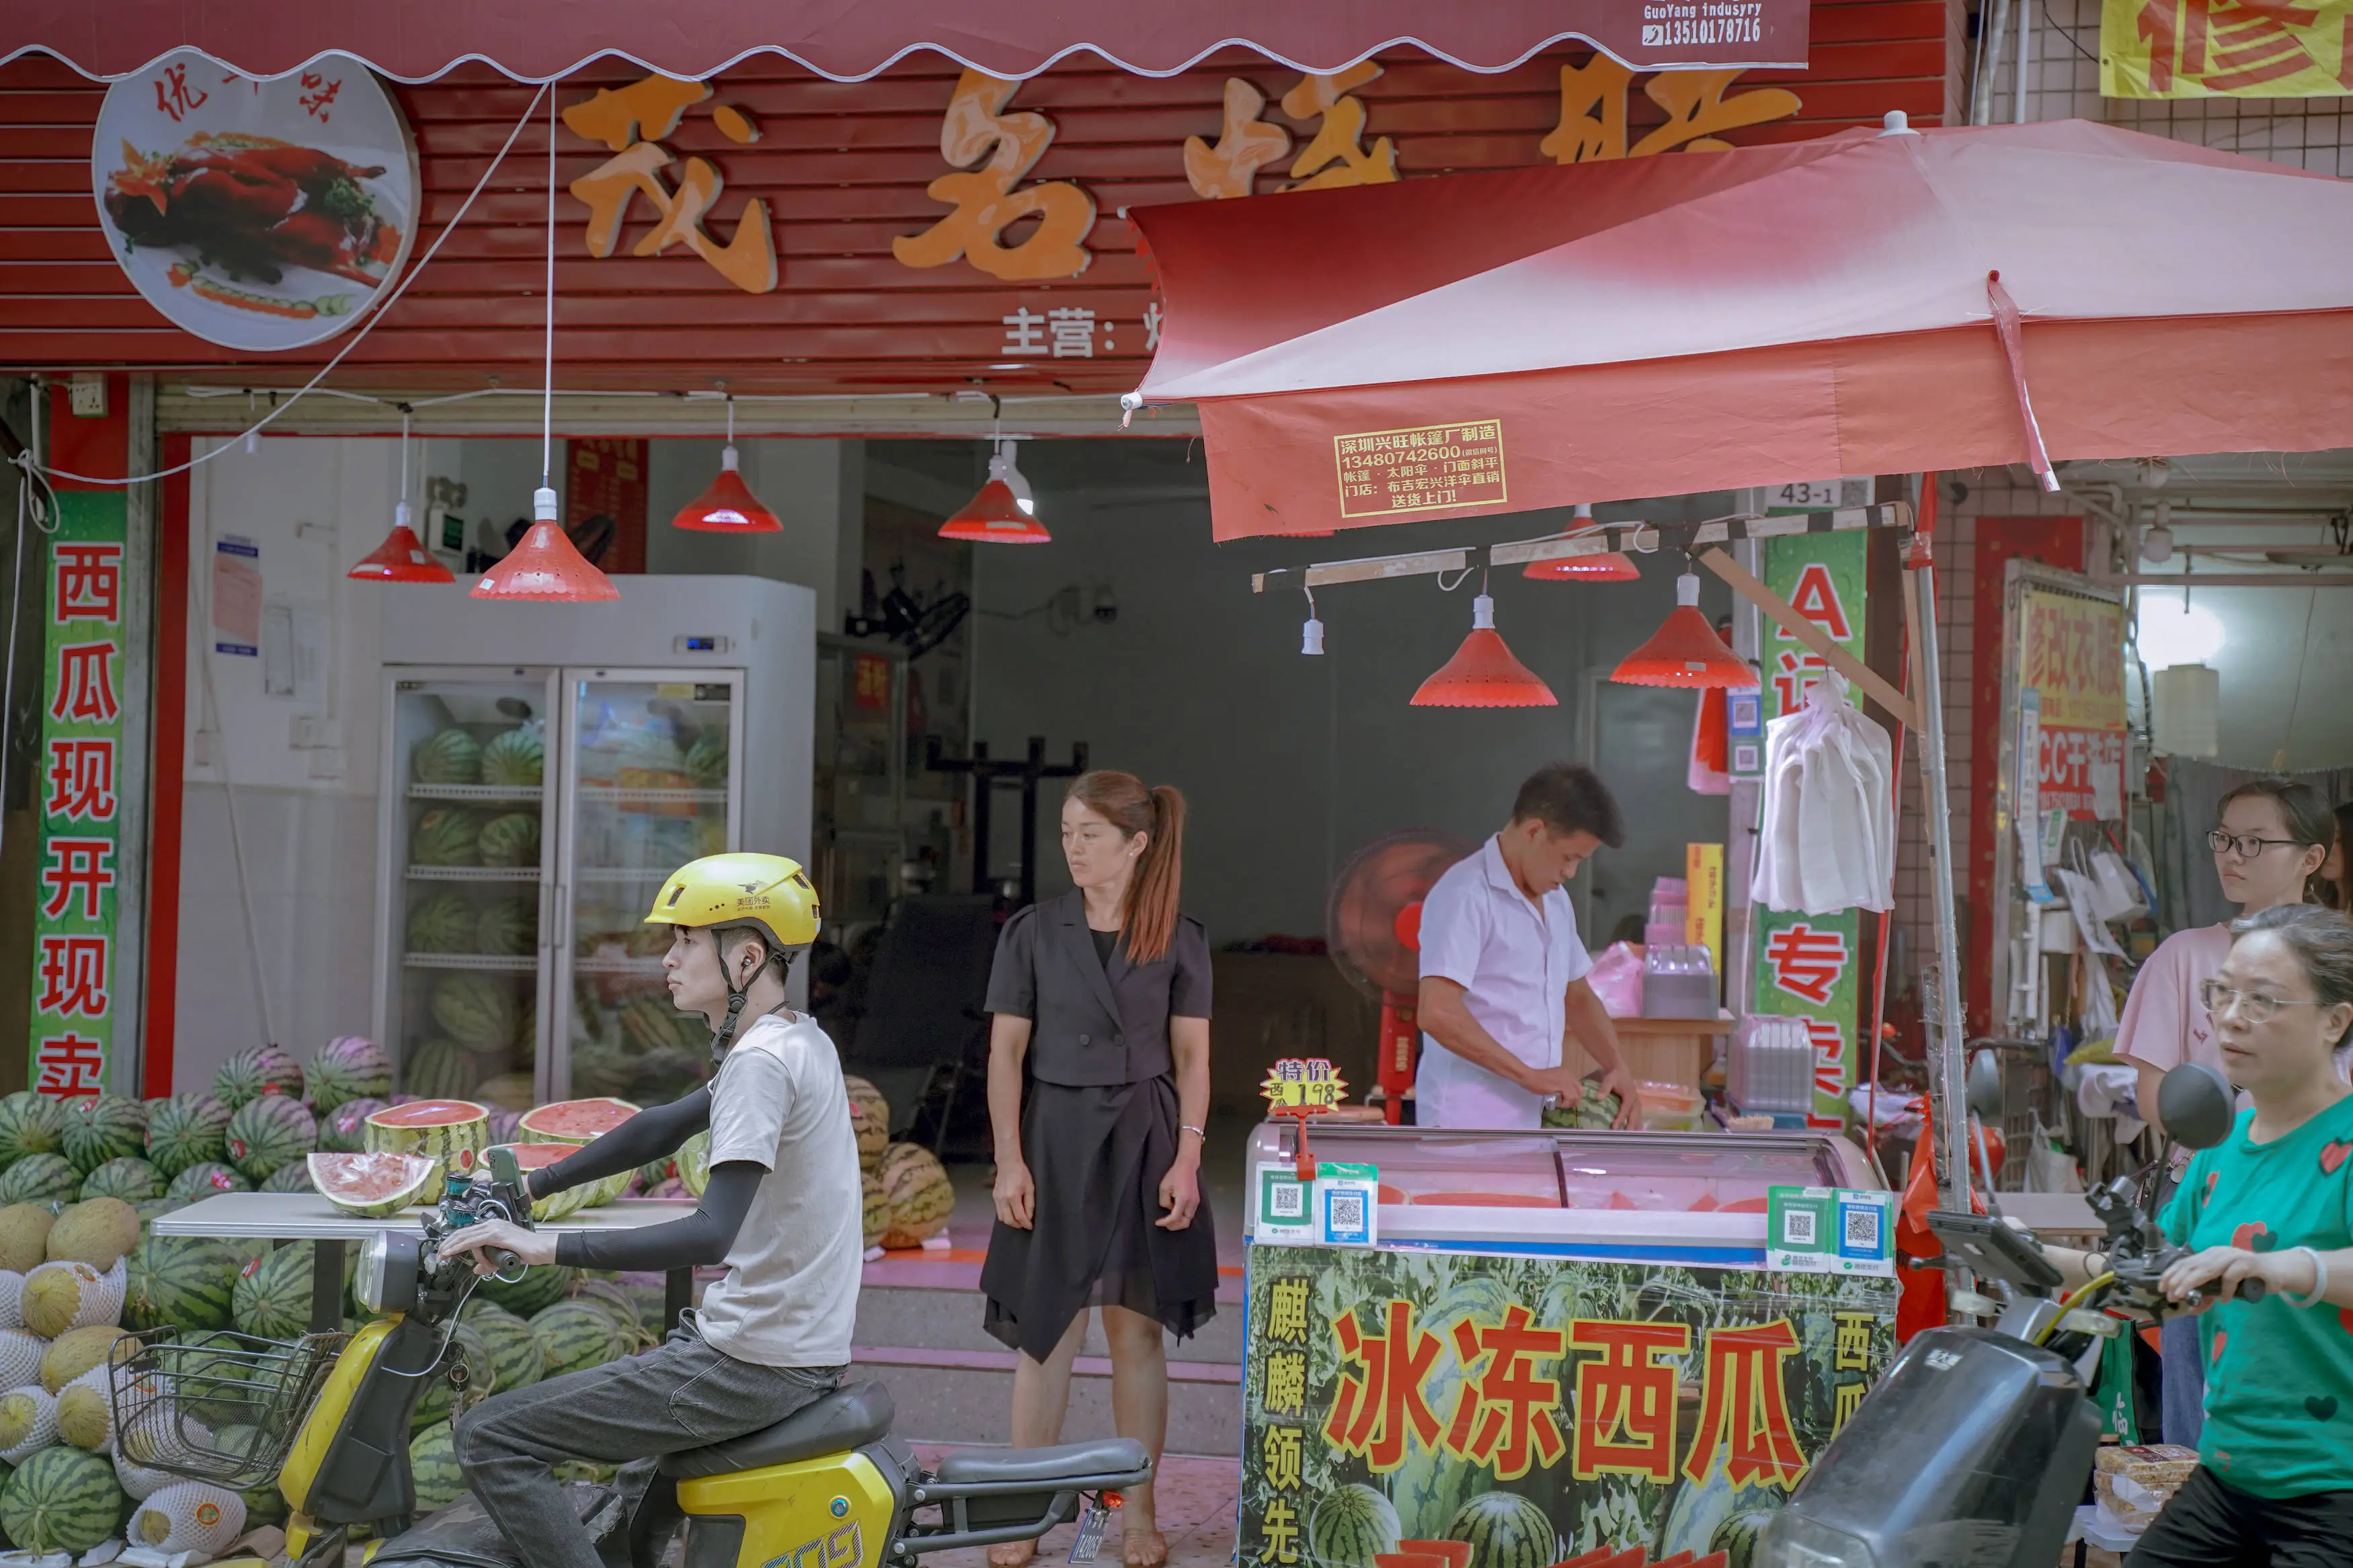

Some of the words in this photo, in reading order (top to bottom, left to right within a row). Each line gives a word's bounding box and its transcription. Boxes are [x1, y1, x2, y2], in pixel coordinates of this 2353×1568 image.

[1644, 5, 1696, 19] GuoYang
[1702, 2, 1761, 17] indusyry
[1664, 17, 1761, 45] 13510178716
[1341, 425, 1496, 455] 深圳兴旺帐篷厂制造
[1342, 446, 1461, 469] 13480742600
[1780, 483, 1833, 504] 43-1
[37, 542, 124, 1103] 西瓜现开现卖
[1277, 1061, 1330, 1082] 特价
[1322, 1298, 1809, 1493] 冰冻西瓜
[1261, 1278, 1310, 1565] 麒麟领先
